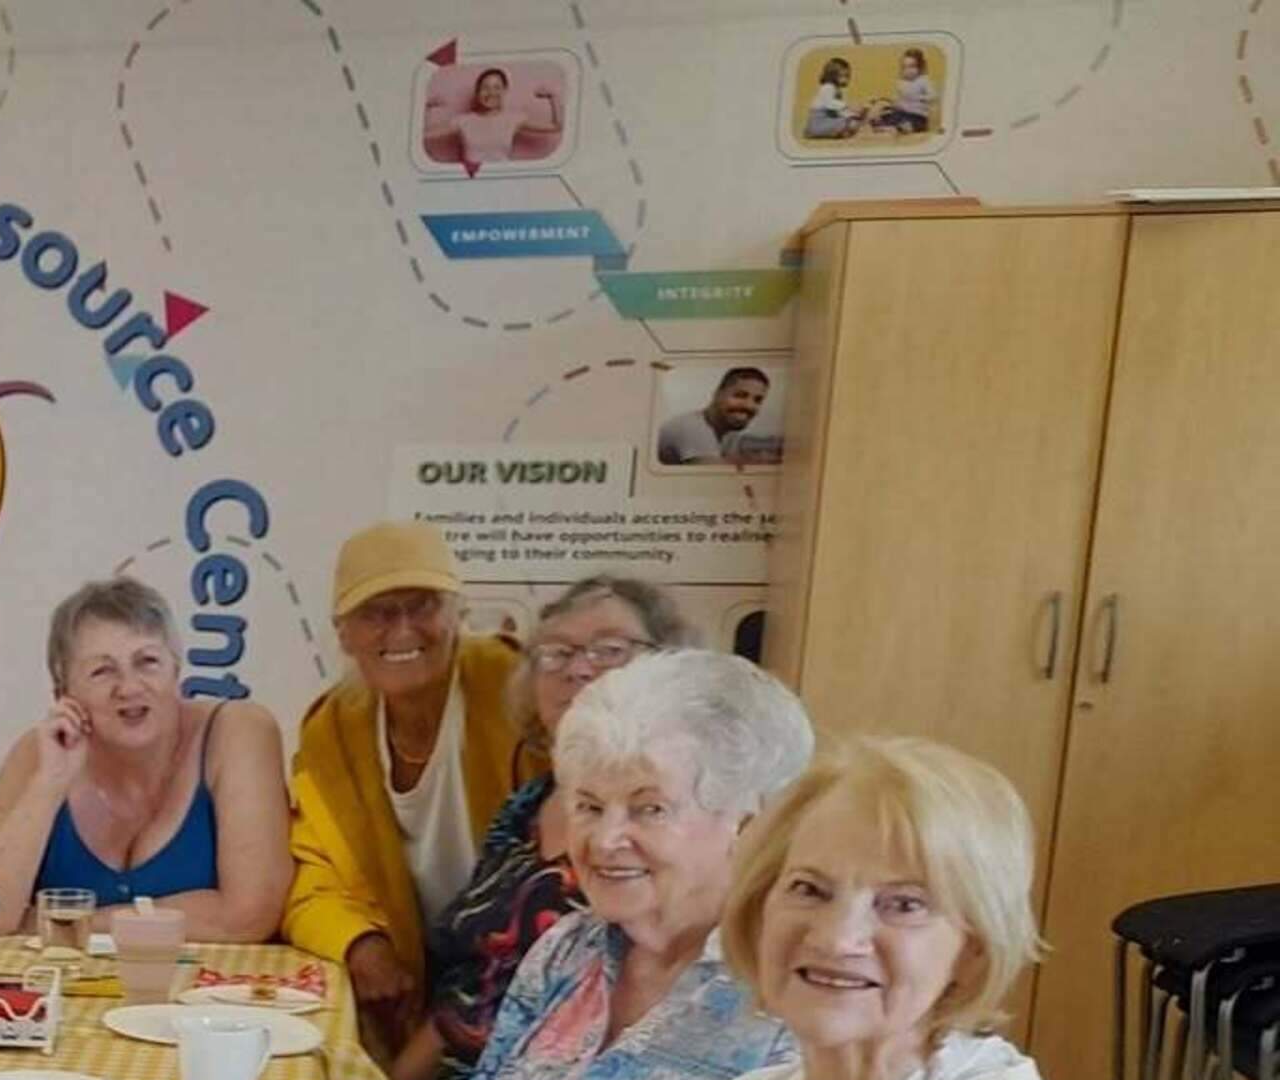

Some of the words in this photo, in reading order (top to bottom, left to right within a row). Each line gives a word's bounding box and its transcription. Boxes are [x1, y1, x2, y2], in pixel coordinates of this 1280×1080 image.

[450, 226, 592, 243] EMPOWERMENT
[656, 285, 755, 301] INTEGRITY
[417, 460, 488, 485] OUR
[498, 460, 608, 485] VISION
[490, 511, 525, 524] and
[528, 511, 627, 524] individuals
[631, 511, 717, 527] accessing
[723, 511, 752, 524] the
[475, 529, 507, 542] will
[511, 529, 554, 542] have
[559, 531, 682, 545] opportunities
[686, 531, 707, 543] to
[501, 548, 521, 561] to
[524, 548, 567, 561] their
[181, 478, 269, 700] Cent
